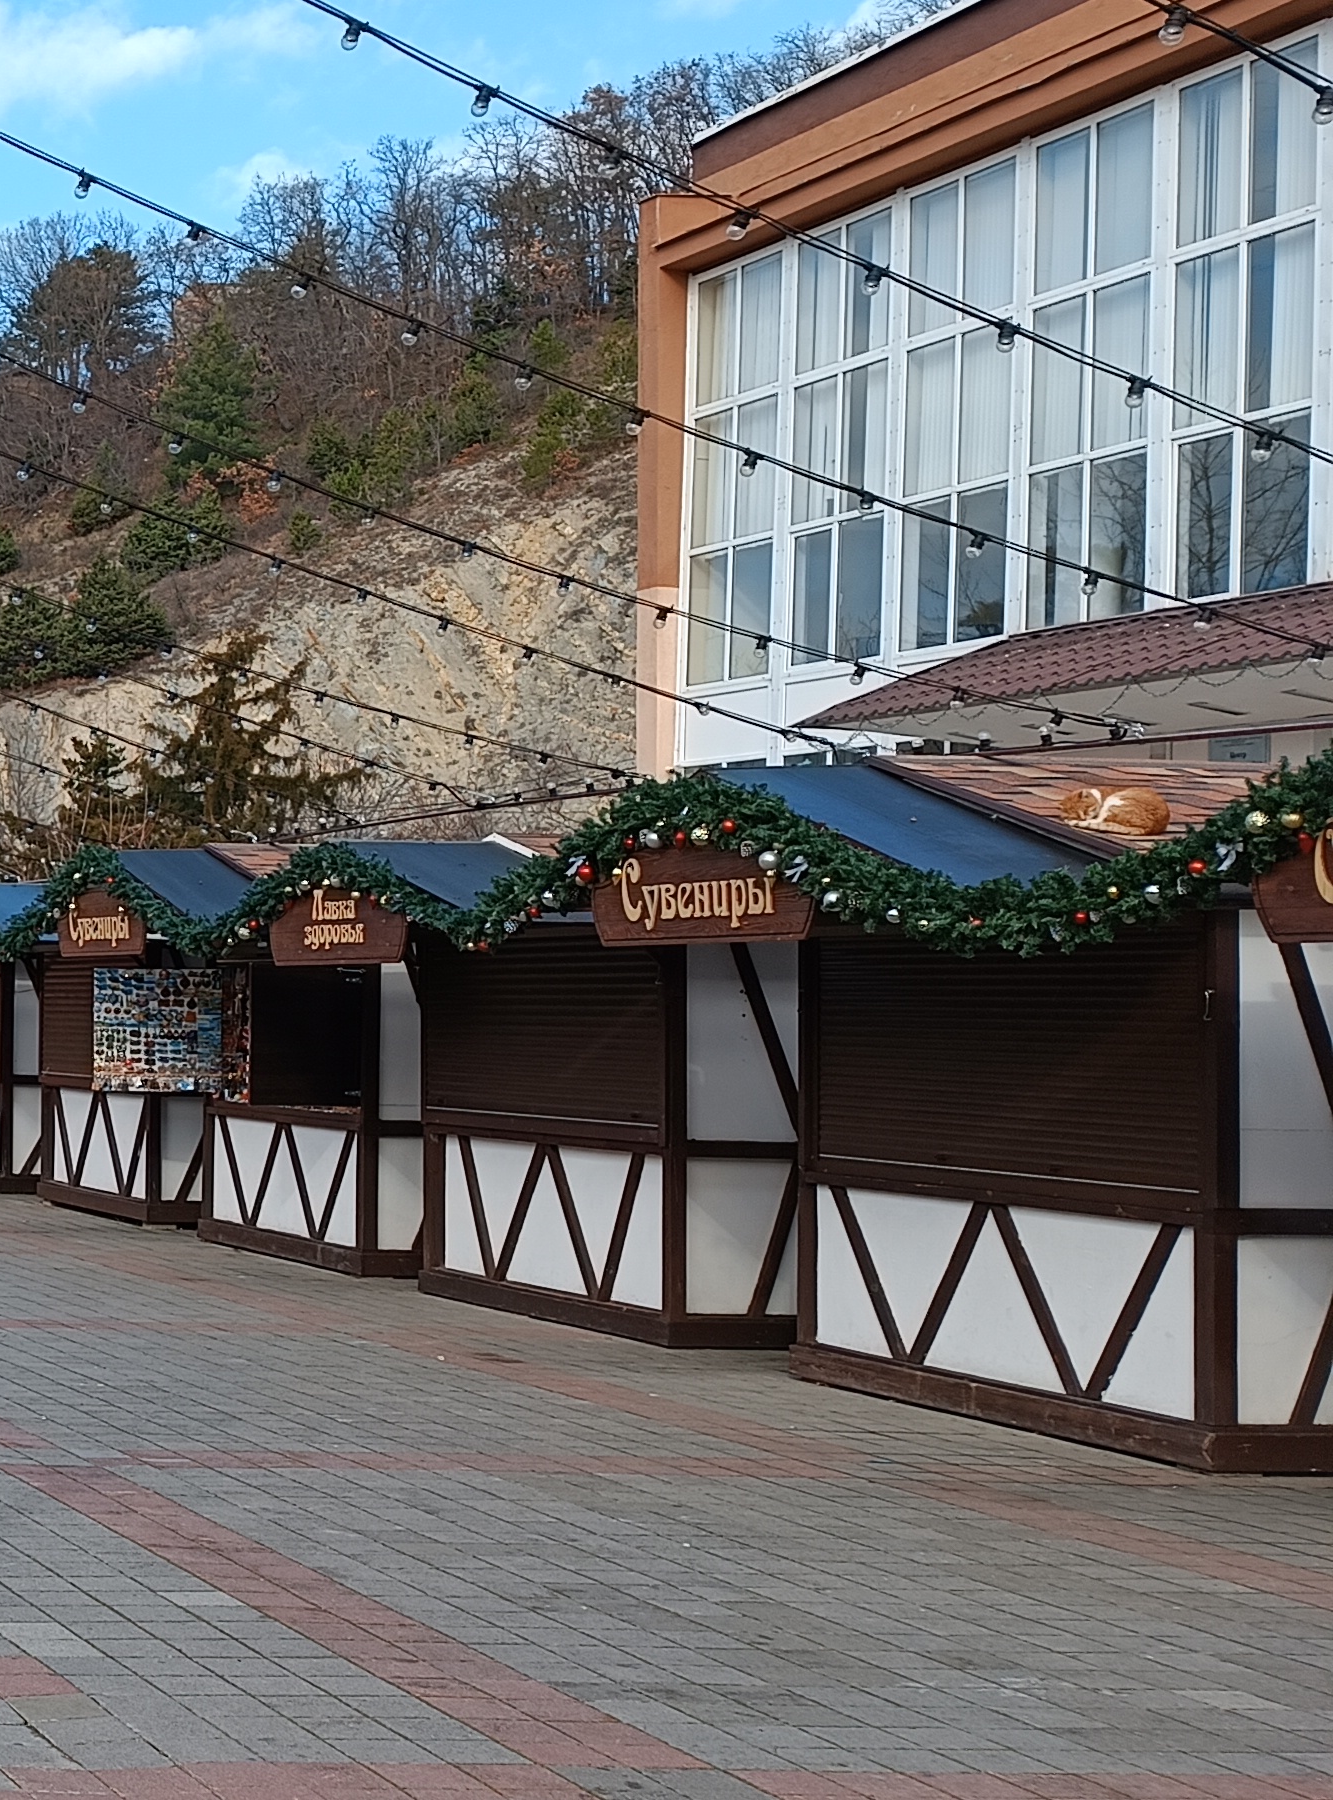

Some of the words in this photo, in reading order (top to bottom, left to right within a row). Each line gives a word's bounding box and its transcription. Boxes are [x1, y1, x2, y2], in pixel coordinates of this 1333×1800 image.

[312, 889, 356, 921] Лавка
[621, 857, 776, 931] Сувениры
[68, 910, 130, 947] Сувениры
[303, 923, 365, 950] здоровья
